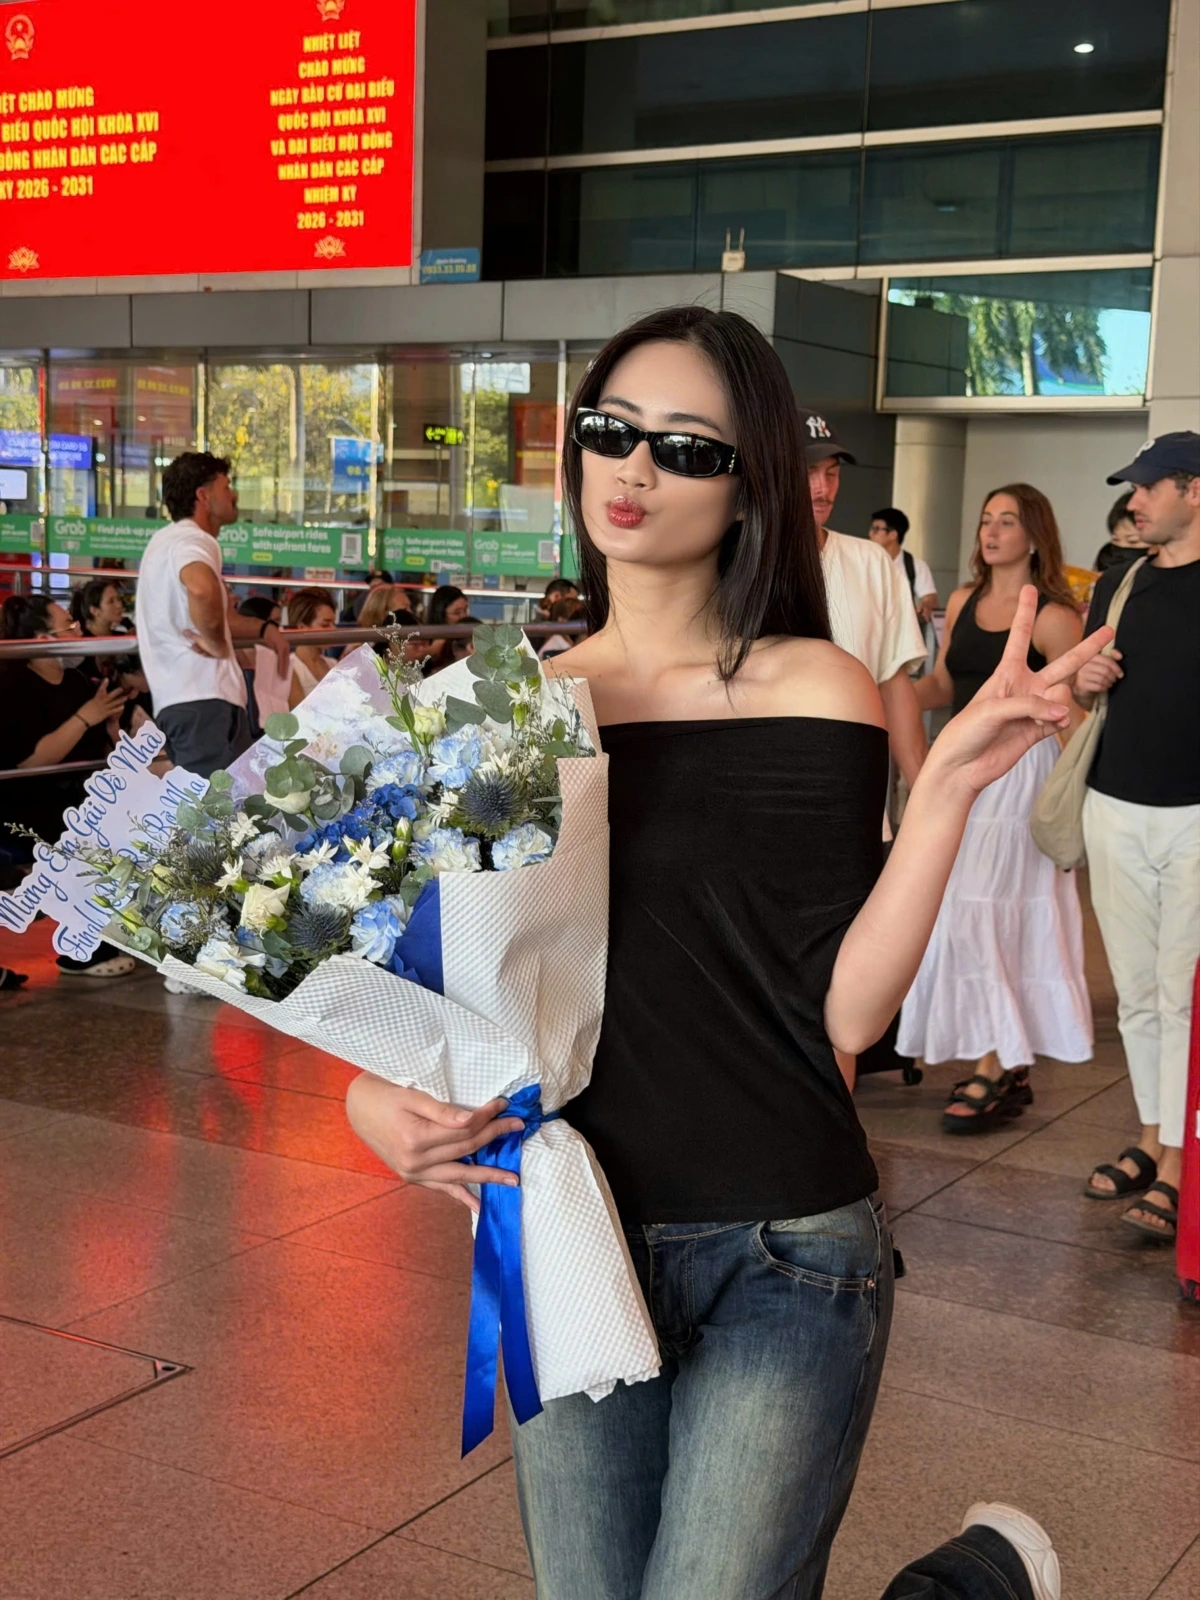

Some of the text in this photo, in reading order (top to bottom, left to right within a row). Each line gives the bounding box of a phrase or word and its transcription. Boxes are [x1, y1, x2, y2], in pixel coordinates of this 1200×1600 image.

[303, 30, 361, 53] NHIỆT LIỆT
[299, 56, 365, 79] CHÀO MỪNG
[18, 90, 53, 112] CHÀO
[56, 86, 95, 109] MỪNG
[1, 111, 159, 143] BIỂU QUỐC HỘI KHÓA XVI
[278, 109, 309, 132] QUỐC
[310, 109, 331, 130] HỘI
[366, 106, 386, 124] XVI
[33, 145, 67, 169] NHÂN
[70, 143, 96, 167] DÂN
[100, 141, 127, 165] CÁC
[130, 137, 157, 163] CẤP
[270, 138, 286, 156] VÀ
[338, 132, 358, 153] HỘI
[278, 154, 385, 181] NHÂN DÂN CÁC CẤP
[16, 178, 49, 199] 2026
[61, 175, 93, 197] 2031
[304, 185, 339, 205] NHIỆM
[297, 211, 326, 229] 2026
[335, 209, 364, 228] 2031
[54, 520, 87, 535] Grab
[252, 527, 328, 543] Safe airport rides
[273, 542, 307, 553] upfront
[474, 538, 499, 551] Grab
[66, 801, 110, 848] Gái
[88, 772, 127, 804] Về
[110, 732, 163, 774] Nhà
